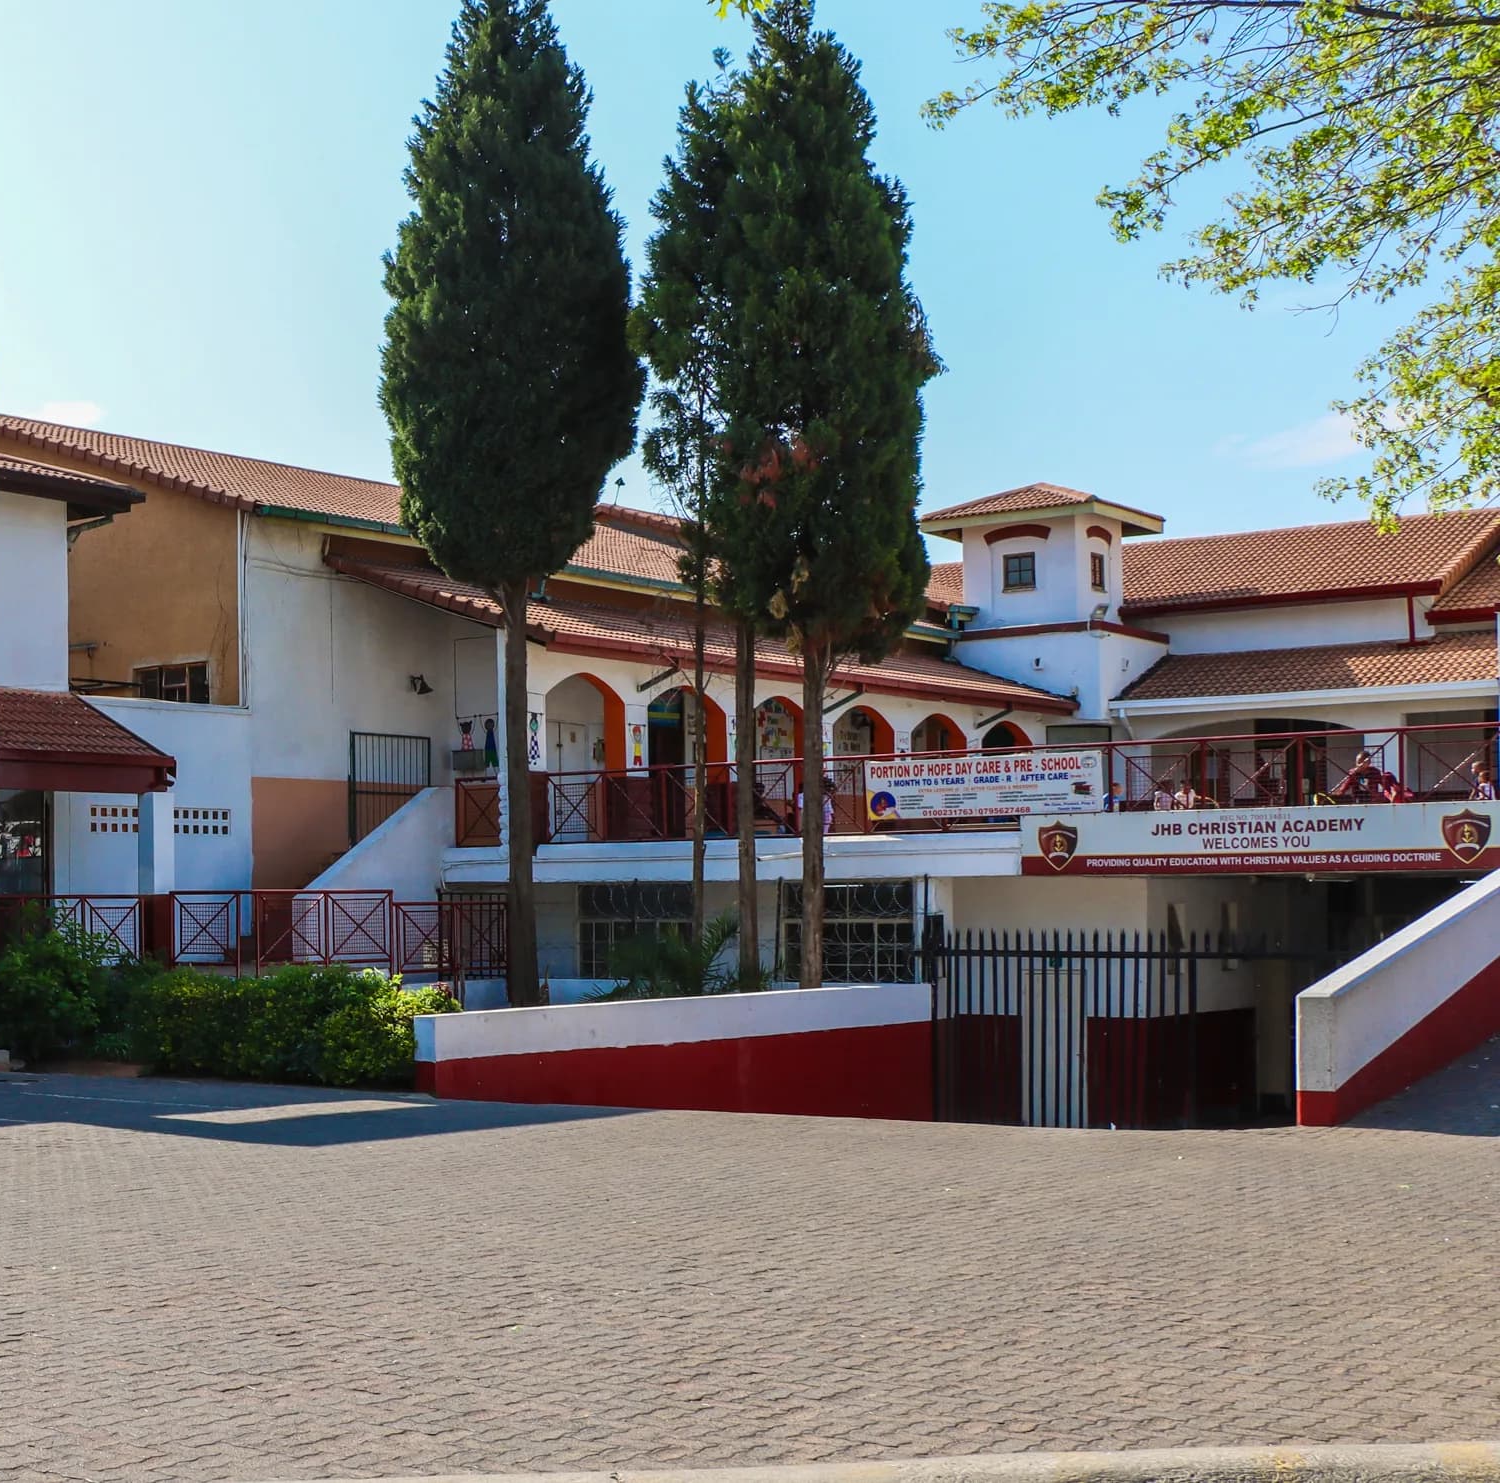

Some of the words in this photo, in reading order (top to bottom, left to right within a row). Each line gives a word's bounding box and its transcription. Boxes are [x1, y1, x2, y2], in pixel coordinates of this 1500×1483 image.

[870, 764, 910, 779] PORTION
[913, 764, 925, 777] OF
[927, 763, 953, 776] HOPE
[955, 762, 973, 775] DAY
[975, 760, 1002, 775] CARE
[1004, 760, 1011, 773] &
[1014, 759, 1033, 773] PRE
[1041, 756, 1082, 771] SCHOOL
[887, 780, 892, 788] 3
[893, 779, 920, 787] MONTH
[922, 778, 932, 786] TO
[934, 778, 939, 786] 6
[941, 777, 965, 785] YEARS
[973, 775, 999, 784] GRADE
[1006, 775, 1012, 783] R
[1020, 773, 1045, 782] AFTER
[1047, 772, 1069, 780] CARE
[1151, 823, 1182, 836] JHB
[1188, 820, 1277, 835] CHRISTIAN
[1282, 818, 1365, 833] ACADEMY
[1202, 837, 1278, 849] WELCOMES
[1282, 836, 1311, 848] YOU
[1086, 858, 1130, 867] PROVIDING
[1132, 857, 1167, 867] QUALITY
[1169, 857, 1218, 866] EDUCATION
[1219, 856, 1241, 865] WITH
[1243, 855, 1290, 865] CHRISTIAN
[1291, 854, 1327, 864] VALUES
[1328, 854, 1341, 864] AS
[1343, 854, 1350, 863] A
[1352, 853, 1390, 863] GUIDING
[1392, 852, 1442, 862] DOCTRINE
